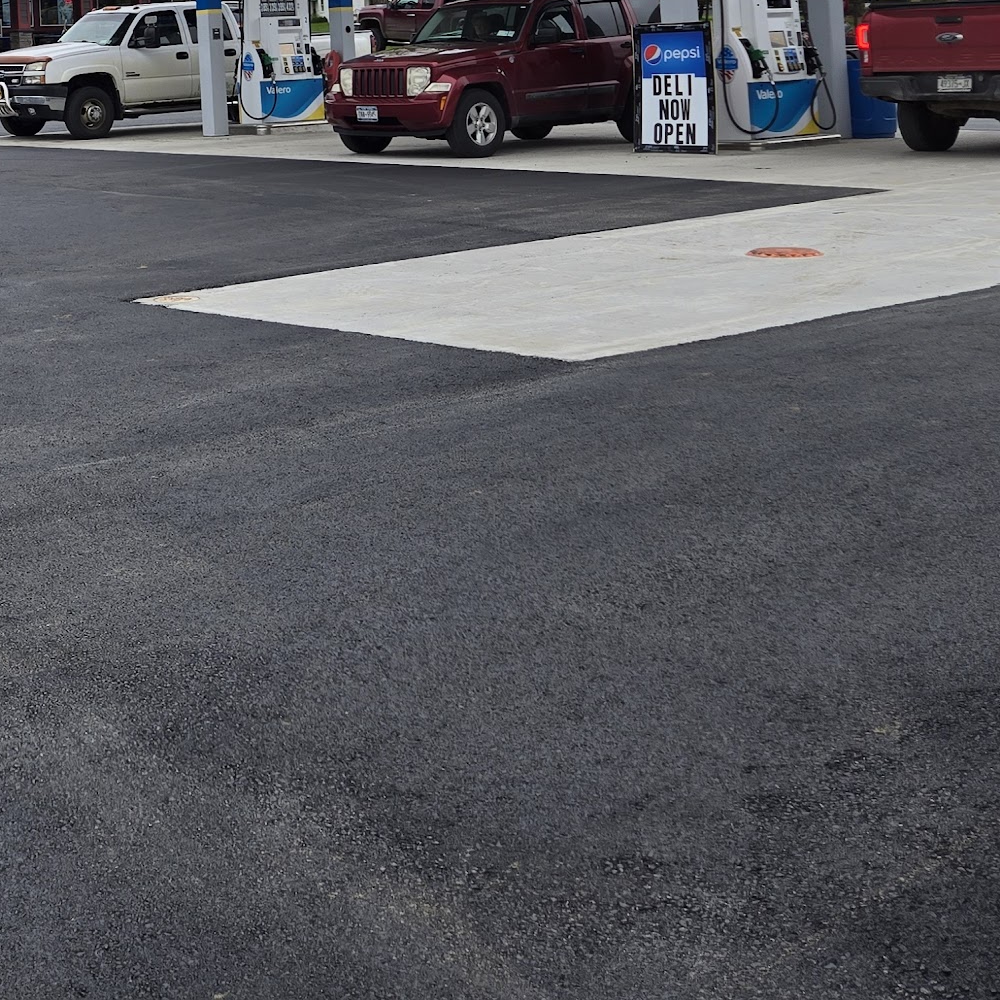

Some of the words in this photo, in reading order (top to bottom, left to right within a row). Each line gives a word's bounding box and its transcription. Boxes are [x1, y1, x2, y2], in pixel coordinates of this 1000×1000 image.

[663, 45, 701, 62] pepsi
[652, 74, 693, 97] DELI
[755, 89, 784, 100] Valeo
[659, 98, 691, 121] NOW
[653, 122, 697, 145] OPEN
